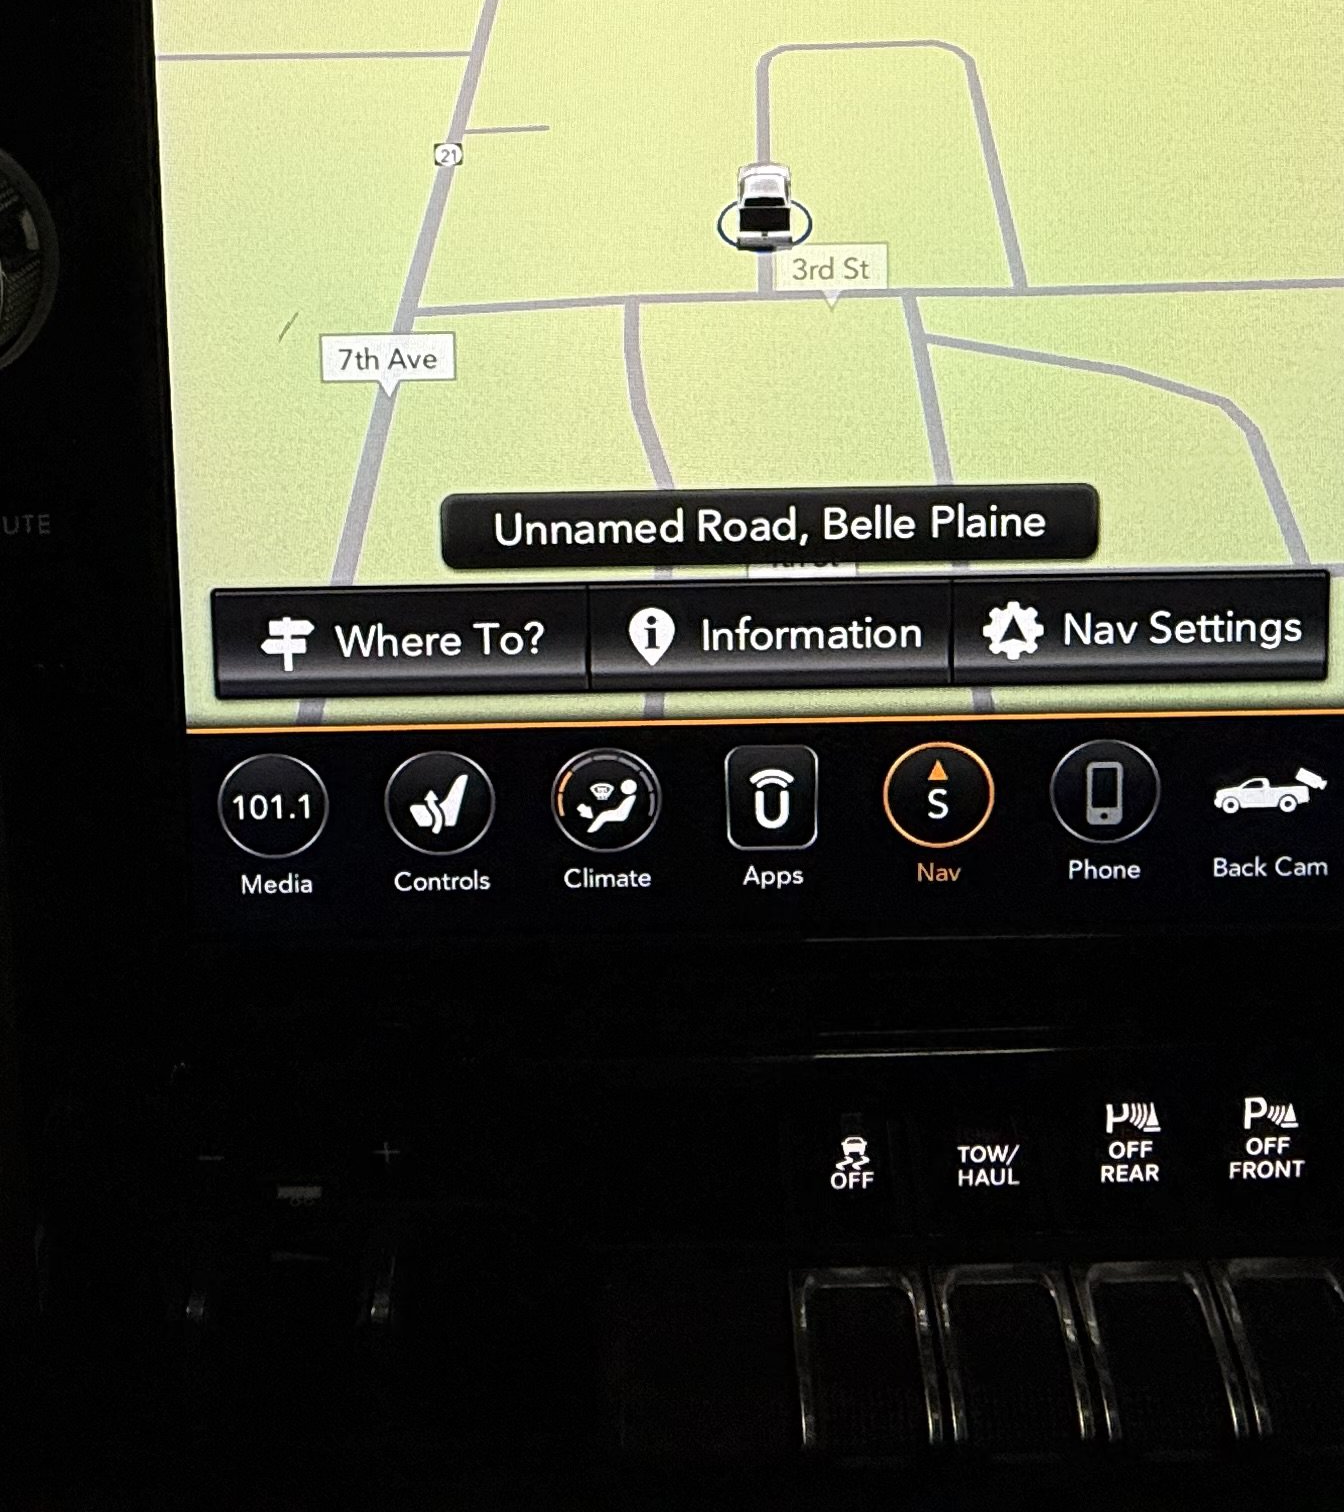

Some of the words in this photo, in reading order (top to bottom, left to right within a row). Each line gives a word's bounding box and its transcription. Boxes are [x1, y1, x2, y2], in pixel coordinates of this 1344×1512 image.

[440, 148, 457, 163] 21
[790, 257, 836, 281] 3rd
[842, 256, 871, 281] St
[337, 345, 380, 372] 7th
[386, 346, 439, 371] Ave
[493, 507, 685, 547] Unnamed
[696, 505, 810, 547] Road,
[822, 502, 917, 541] Belle
[930, 501, 1047, 540] Plaine
[333, 621, 463, 658] Where
[471, 619, 546, 657] To?
[701, 614, 923, 652] Information
[1063, 611, 1139, 646] Nav
[1149, 609, 1303, 650] Settings
[231, 792, 312, 822] 101.1
[926, 787, 950, 821] S
[562, 866, 653, 890] Climate
[741, 864, 805, 890] Apps
[916, 861, 962, 883] Nav
[1067, 857, 1142, 881] Phone
[1212, 855, 1268, 879] Back
[1273, 855, 1329, 878] Cam
[240, 872, 314, 896] Media
[392, 868, 492, 893] Controls
[956, 1143, 1021, 1166] TOW/
[1107, 1140, 1154, 1160] OFF
[1244, 1136, 1292, 1156] OFF
[829, 1171, 875, 1191] OFF
[957, 1166, 1021, 1188] HAUL
[1099, 1163, 1161, 1184] REAR
[1228, 1159, 1306, 1180] FRONT
